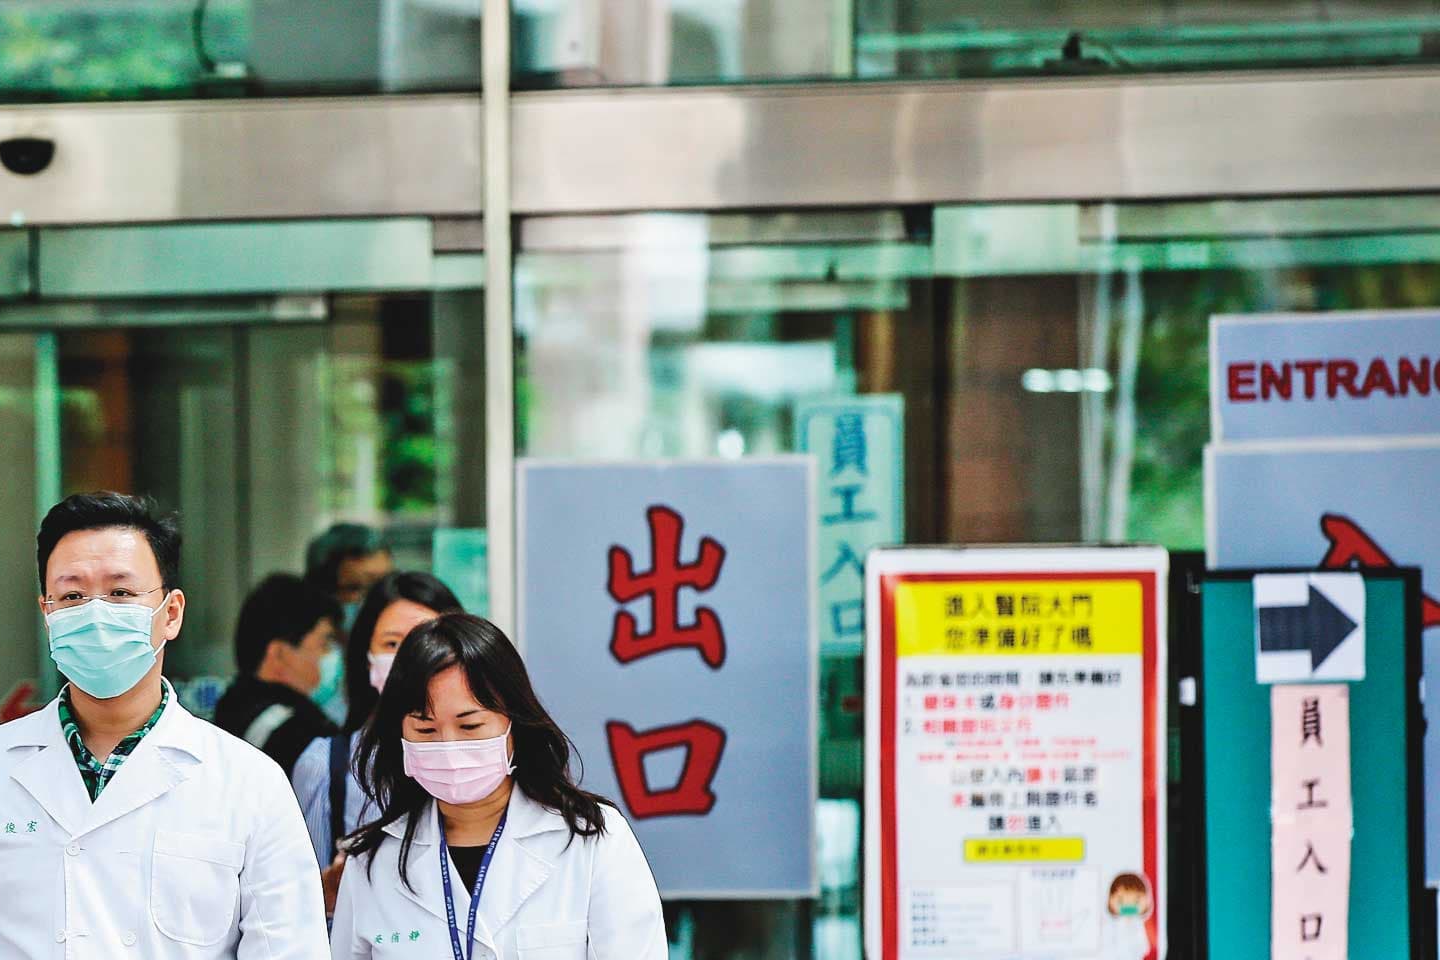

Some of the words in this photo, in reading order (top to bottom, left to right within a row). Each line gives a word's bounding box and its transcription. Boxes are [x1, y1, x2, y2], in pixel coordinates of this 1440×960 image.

[1226, 356, 1440, 402] ENTRAN
[944, 594, 1093, 618] 進入醫院大門
[944, 626, 1093, 649] 您準備好了嗎
[607, 504, 726, 819] 出口
[1296, 696, 1328, 941] 員工入口
